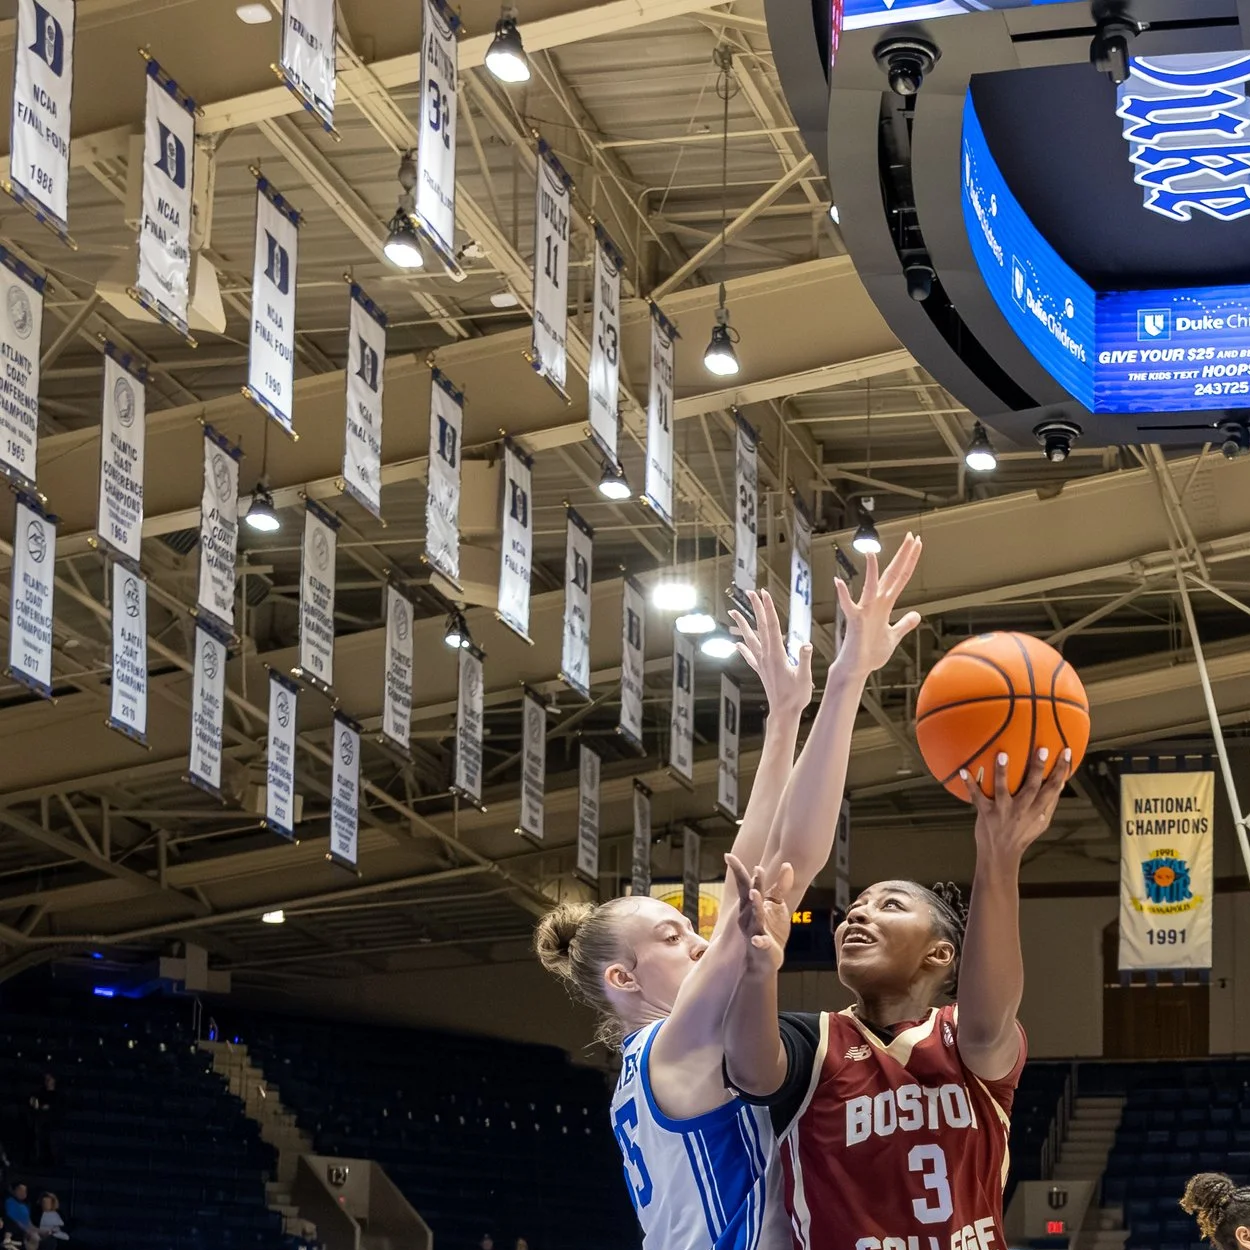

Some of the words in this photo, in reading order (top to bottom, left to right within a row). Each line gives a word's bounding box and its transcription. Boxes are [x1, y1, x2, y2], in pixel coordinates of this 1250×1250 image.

[34, 84, 57, 118] NCAA
[18, 102, 44, 139] FINAL
[157, 197, 180, 228] NCAA
[266, 303, 283, 332] NCAA
[1026, 288, 1048, 327] Duke
[1048, 313, 1087, 363] Children's
[1176, 316, 1224, 332] Duke
[255, 319, 274, 349] FINAL
[1, 342, 32, 376] ATLANTIC
[1099, 351, 1137, 365] GIVE
[1140, 349, 1185, 364] YOUR
[1187, 347, 1216, 362] $25
[1216, 349, 1238, 359] AND
[6, 363, 28, 389] COAST
[1128, 373, 1148, 382] THE
[1148, 371, 1172, 381] KIDS
[1173, 370, 1200, 380] TEXT
[1193, 381, 1250, 396] 243725
[104, 479, 140, 514] CHAMPIONS
[1134, 797, 1200, 814] NATIONAL
[1126, 818, 1208, 836] CHAMPIONS
[791, 911, 812, 924] KE
[1147, 929, 1187, 945] 1991
[846, 1083, 978, 1147] BOSTO
[614, 1097, 653, 1210] 5
[908, 1144, 953, 1225] 3
